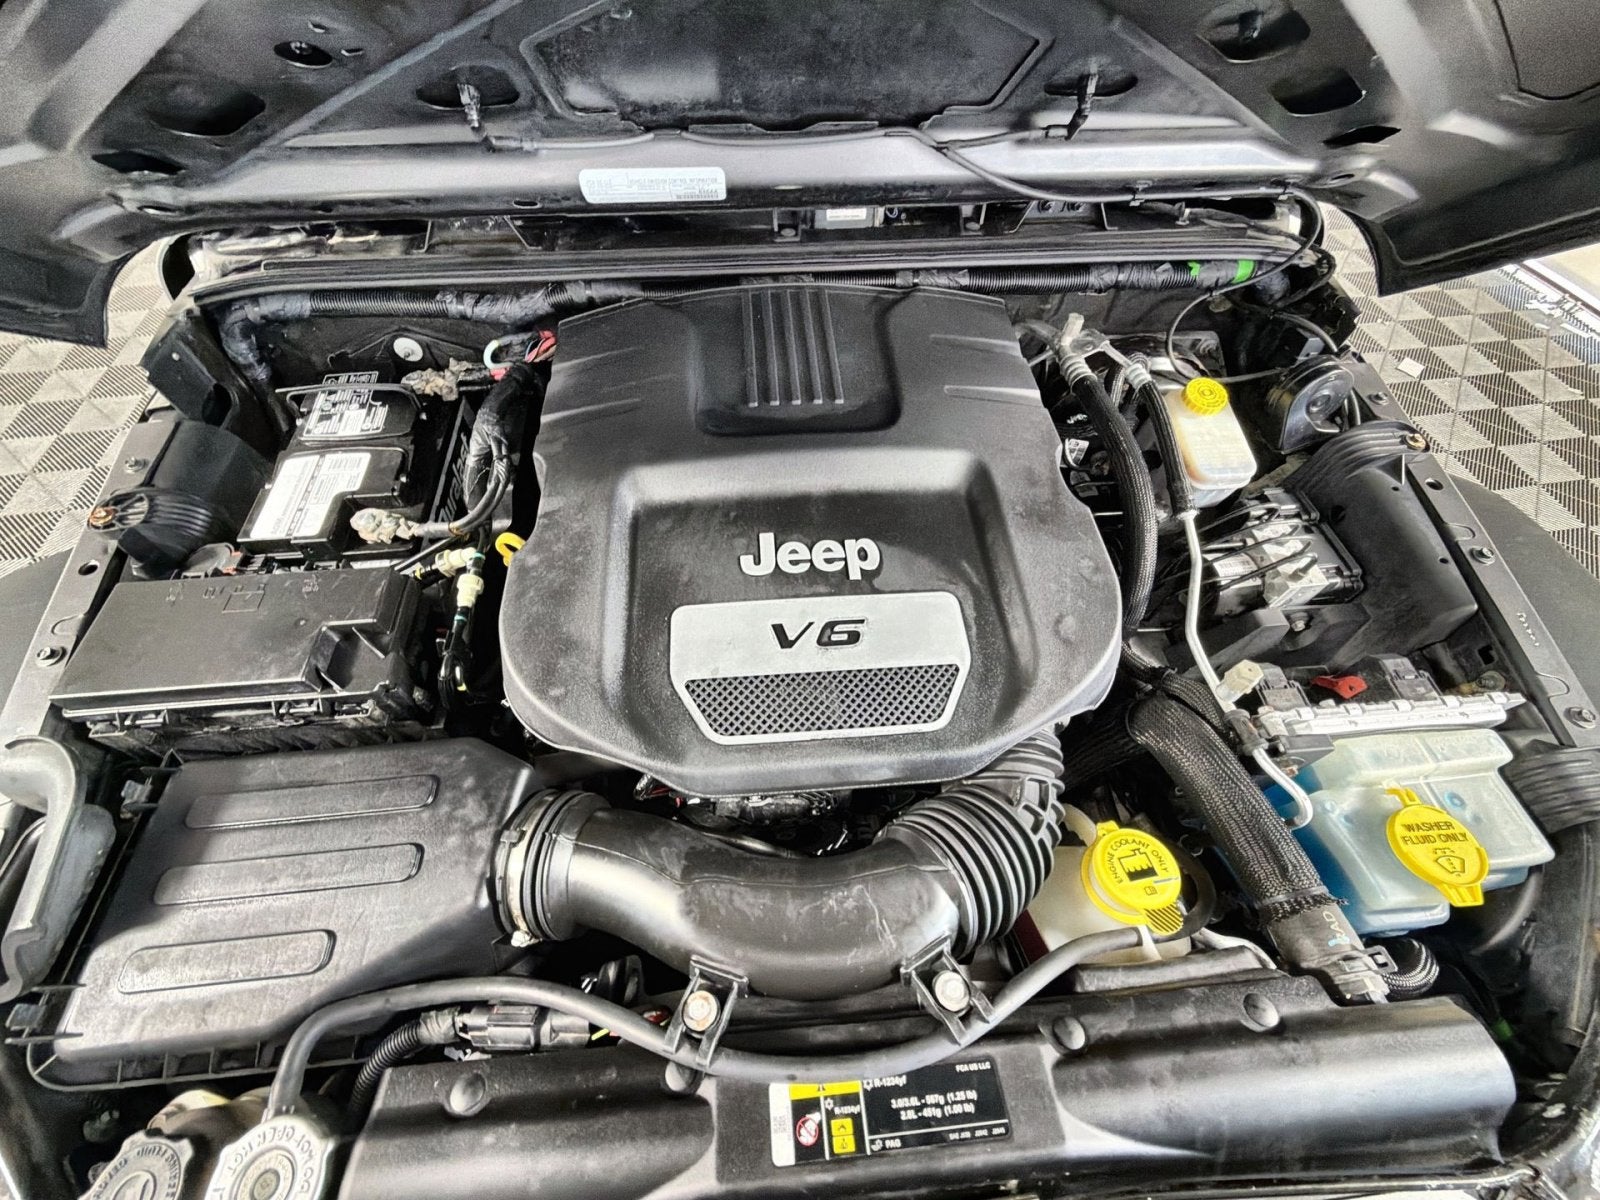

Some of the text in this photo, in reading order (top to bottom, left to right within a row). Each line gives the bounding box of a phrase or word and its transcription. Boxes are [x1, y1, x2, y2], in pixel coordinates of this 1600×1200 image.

[739, 532, 880, 580] Jeep
[771, 619, 865, 649] V6
[1402, 821, 1455, 832] WASHER
[1402, 832, 1469, 845] FLUID ONLY
[1107, 838, 1169, 884] ENGINE COOLANT ONLY
[955, 1064, 969, 1073] FCA
[979, 1061, 991, 1070] LLC
[874, 1075, 907, 1087] R-1234yf
